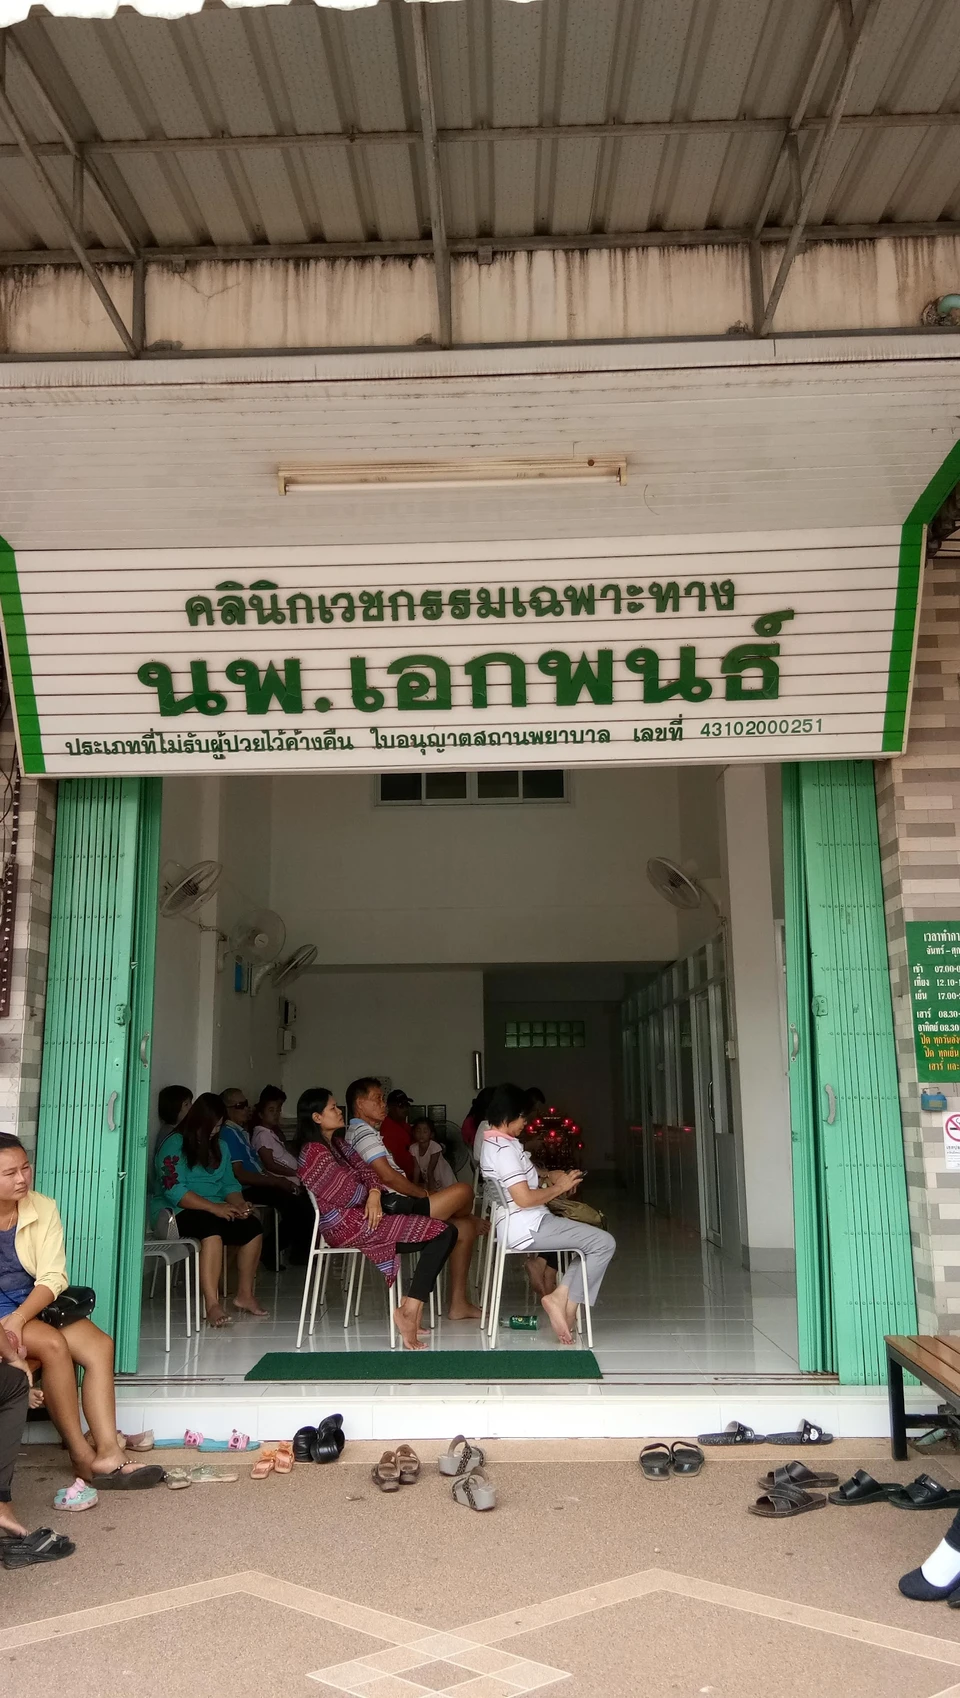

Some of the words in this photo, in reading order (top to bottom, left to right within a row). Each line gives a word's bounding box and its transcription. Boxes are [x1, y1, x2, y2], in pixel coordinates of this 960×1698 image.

[185, 579, 735, 626] คลินิกเวชกรรมเฉพาะทาง
[370, 727, 611, 755] ใบอนุญาตสถานพยาบาล
[633, 714, 684, 742] เลขที่
[700, 718, 823, 737] 43102000251
[937, 992, 960, 1000] 17.00-
